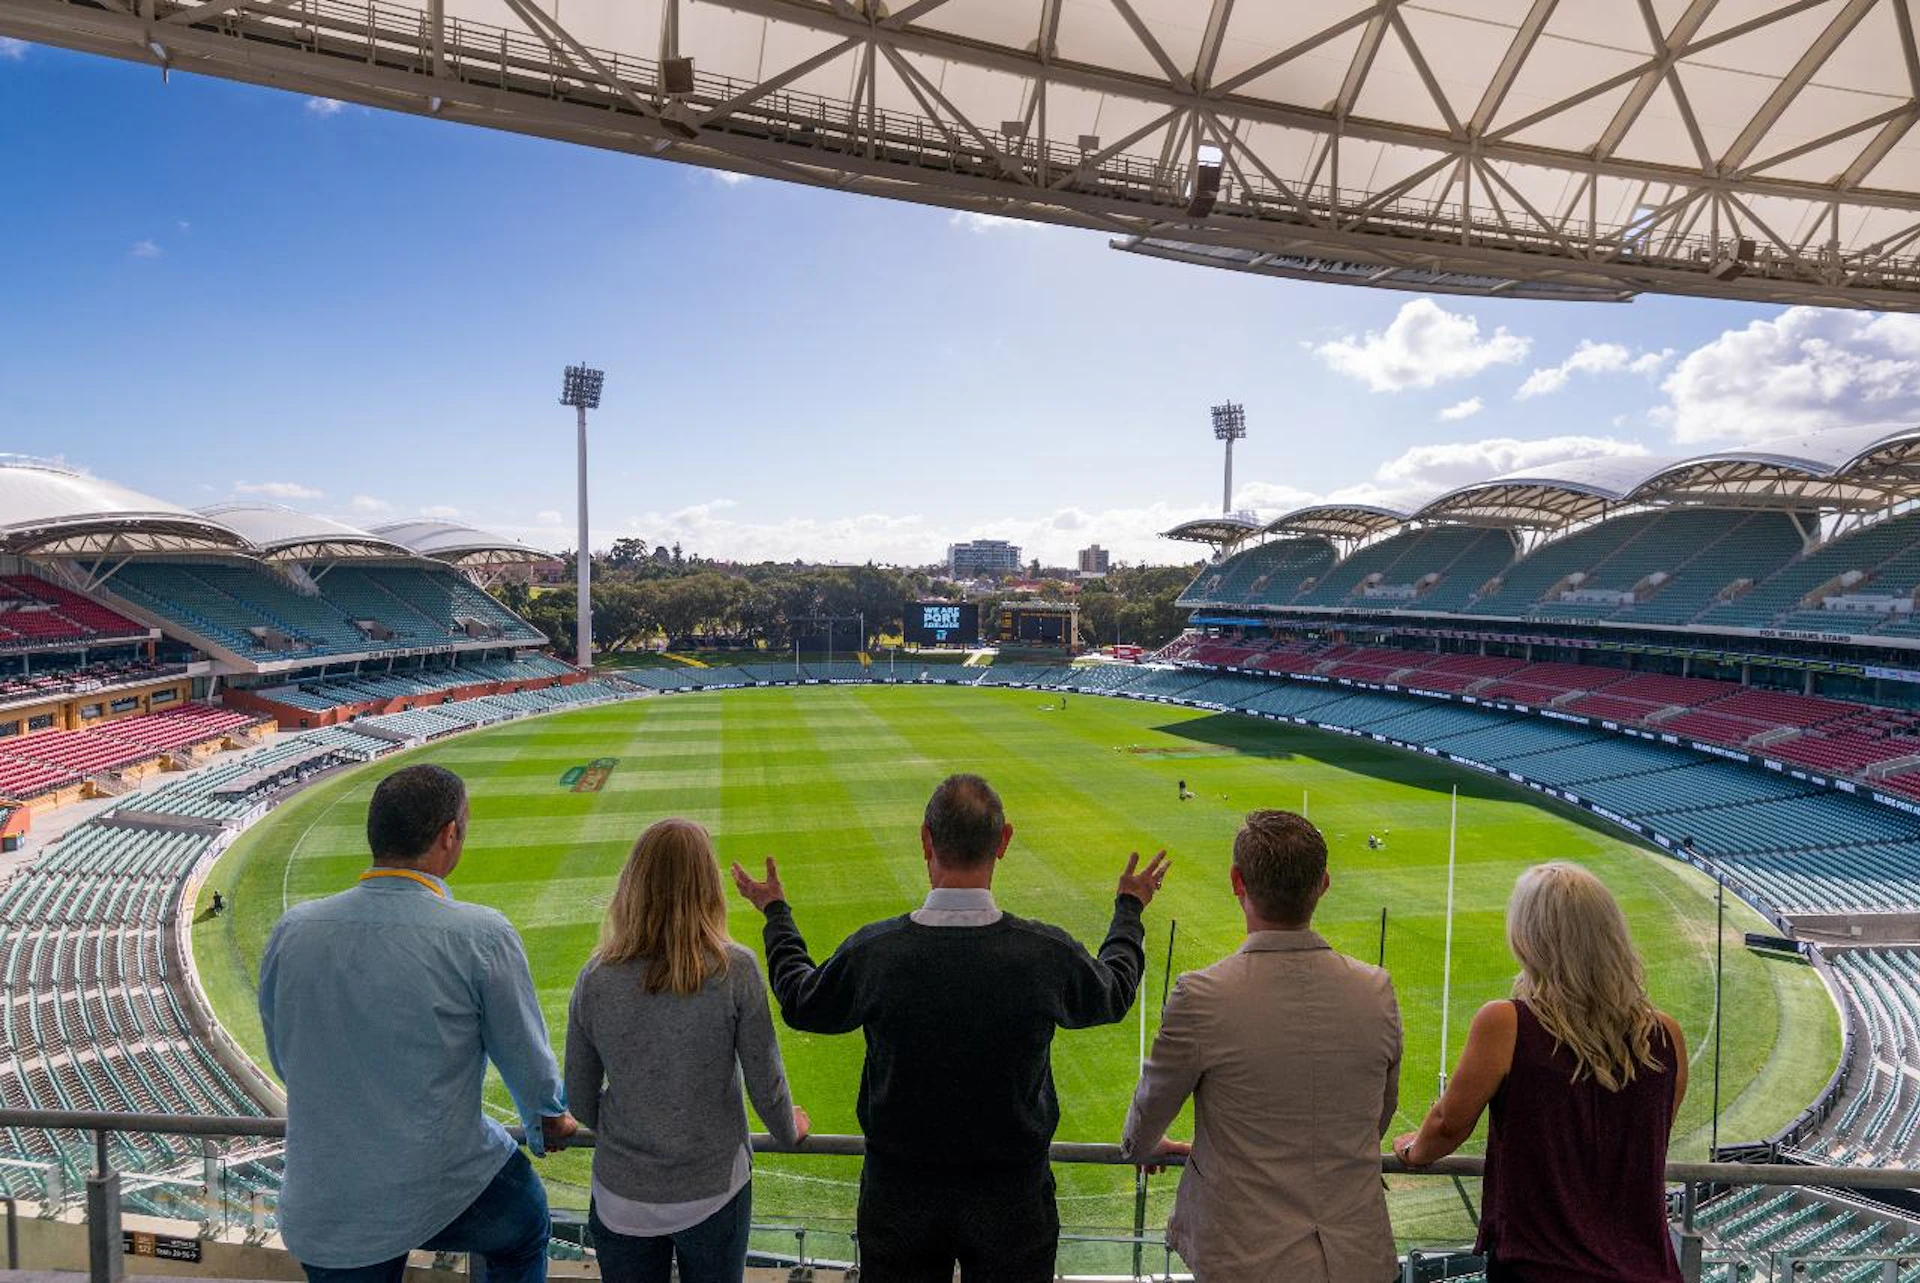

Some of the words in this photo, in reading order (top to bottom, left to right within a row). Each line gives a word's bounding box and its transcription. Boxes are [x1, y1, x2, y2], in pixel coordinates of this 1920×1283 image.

[924, 613, 960, 623] PORT
[1778, 631, 1819, 640] WILLIAMS
[1823, 634, 1851, 643] STAND
